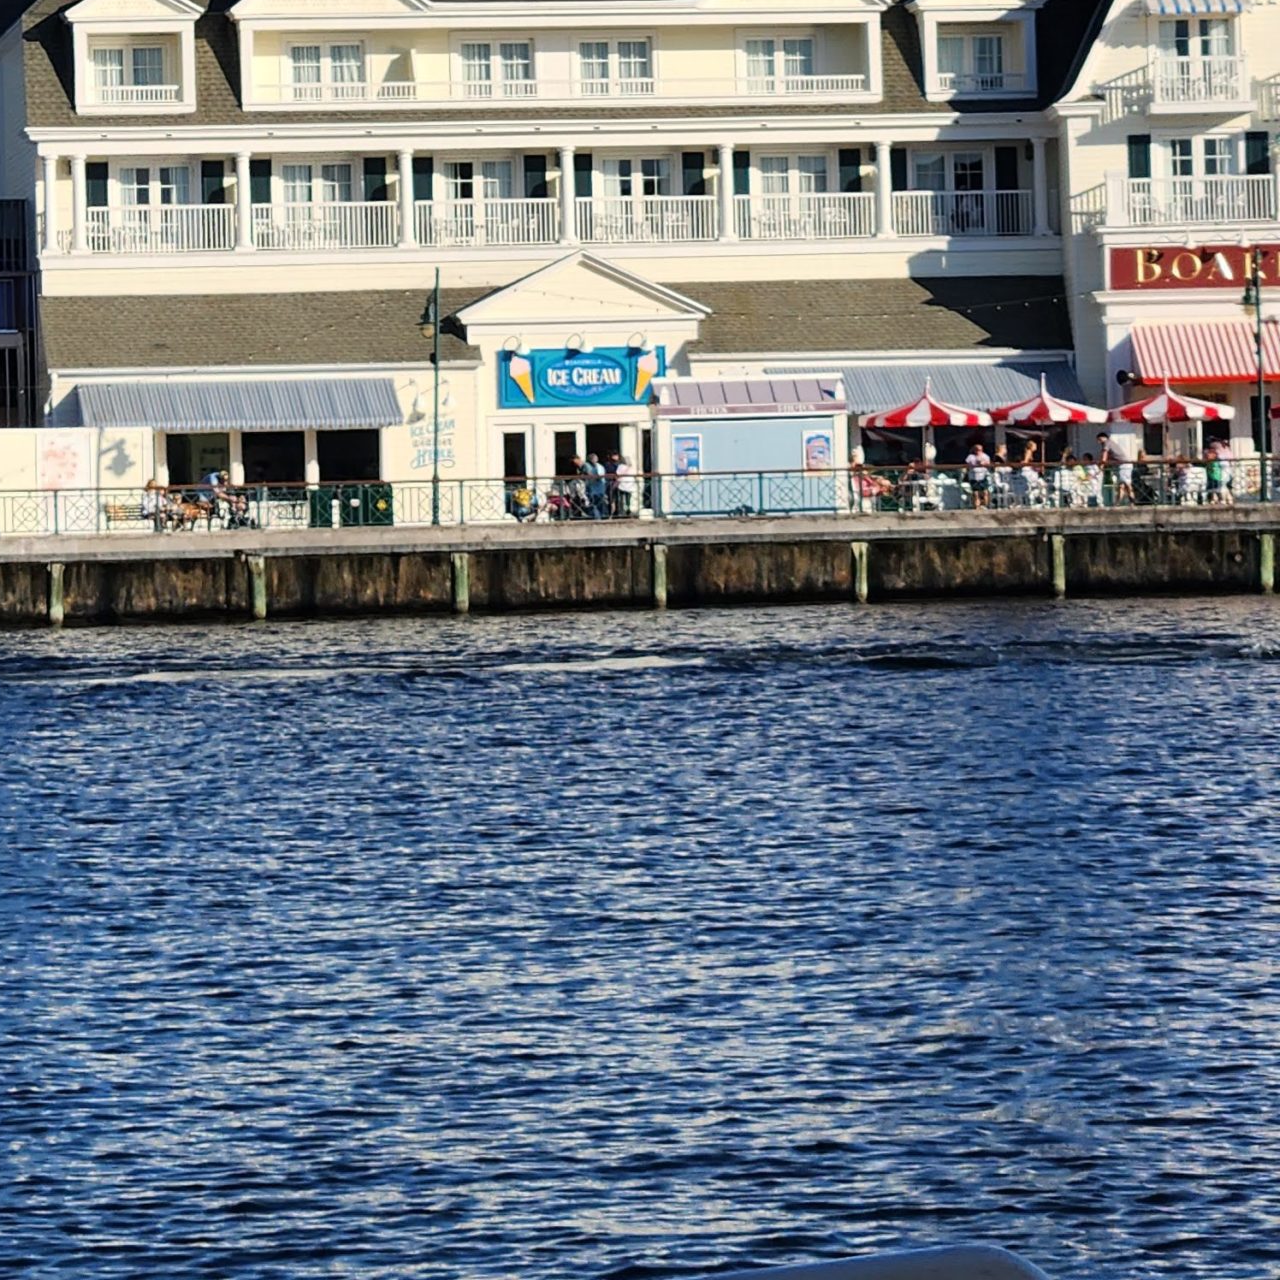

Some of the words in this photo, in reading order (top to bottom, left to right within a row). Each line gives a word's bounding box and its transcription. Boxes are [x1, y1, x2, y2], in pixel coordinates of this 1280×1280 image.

[1135, 248, 1280, 283] BOAR
[547, 368, 570, 386] ICE
[572, 367, 622, 385] CREAM
